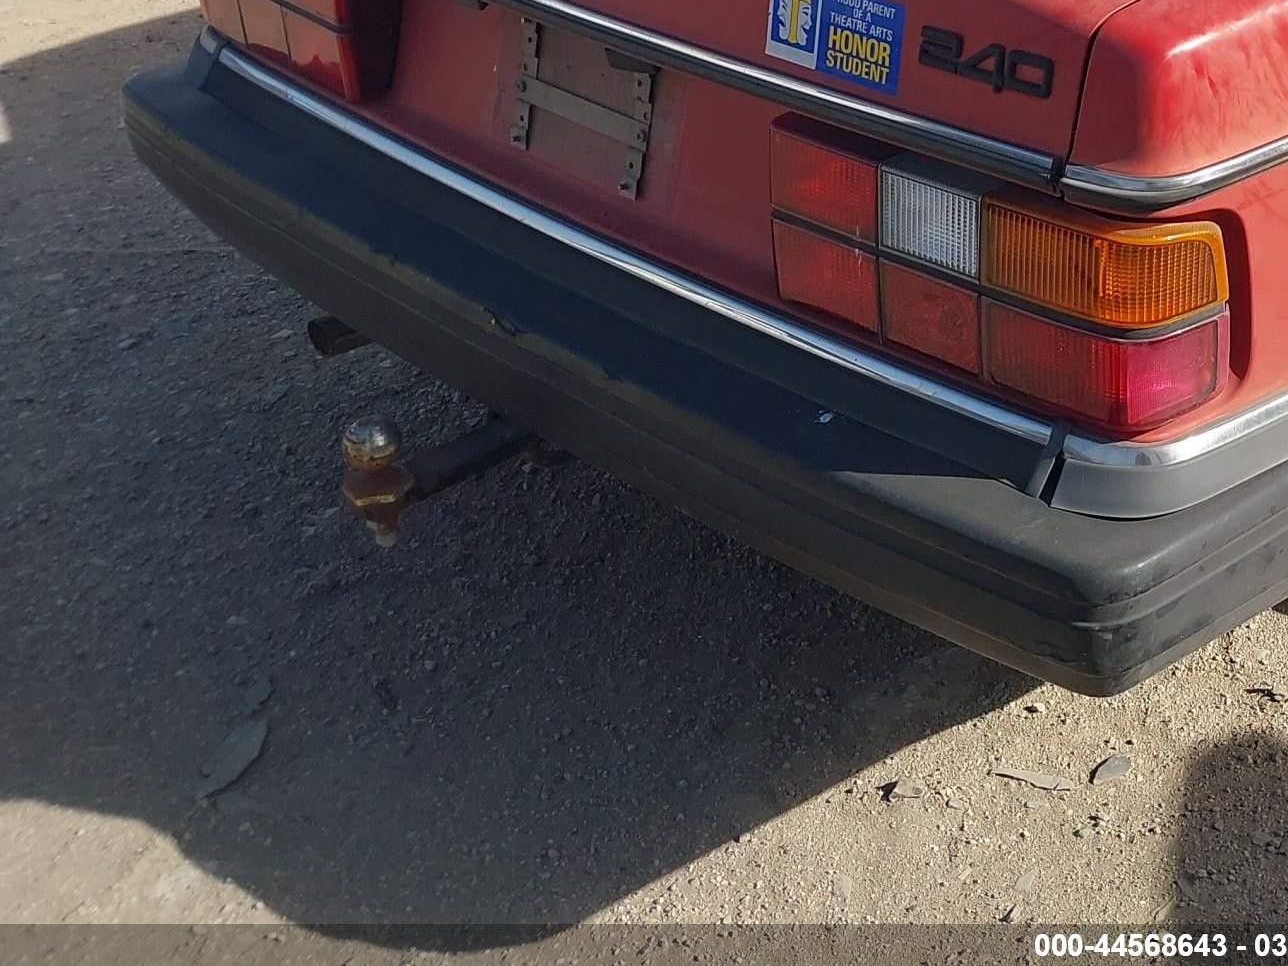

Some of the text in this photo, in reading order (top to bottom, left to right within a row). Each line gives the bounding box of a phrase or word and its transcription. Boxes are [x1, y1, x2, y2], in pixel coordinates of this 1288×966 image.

[830, 11, 894, 41] THEATRE ARTS
[853, 8, 872, 22] OF A
[862, 0, 896, 20] PARENT
[828, 25, 891, 67] HONOR
[918, 25, 1055, 99] 240
[826, 50, 890, 85] STUDENT
